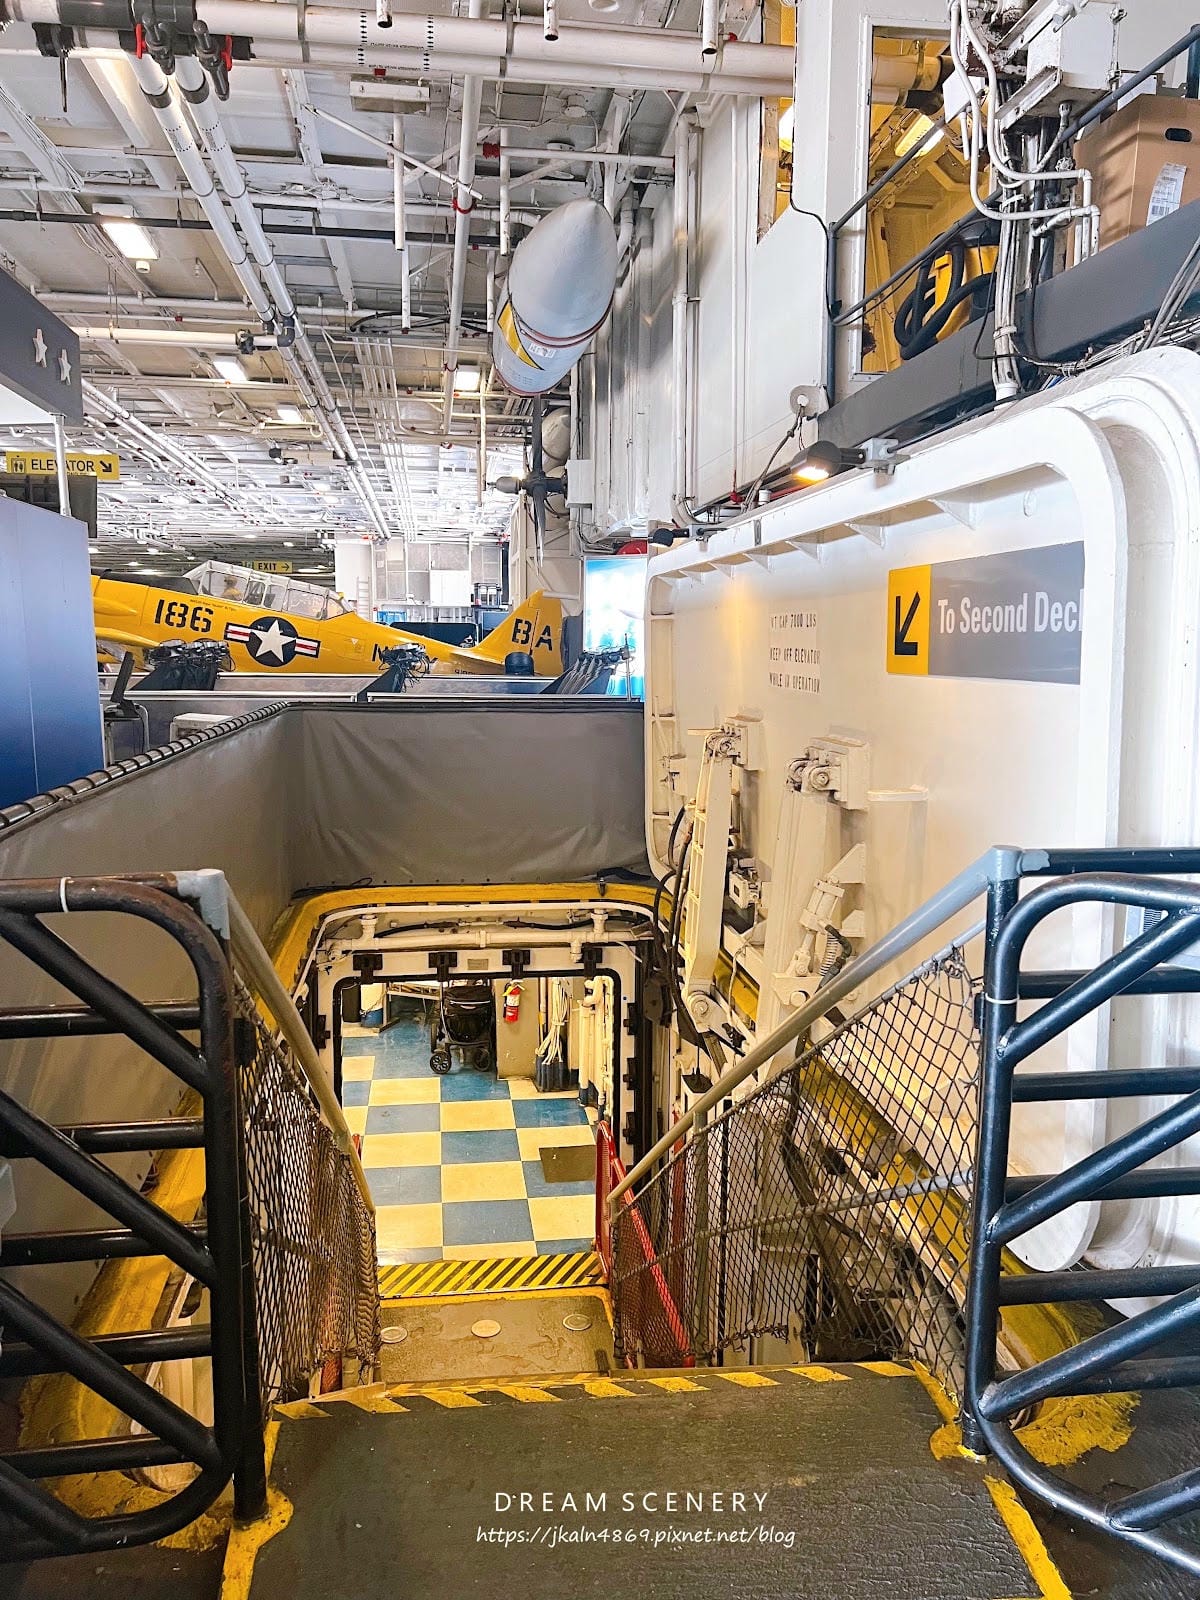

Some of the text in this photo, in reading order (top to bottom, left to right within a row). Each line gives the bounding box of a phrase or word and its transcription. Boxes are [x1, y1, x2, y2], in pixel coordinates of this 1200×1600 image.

[258, 562, 277, 571] EXIT
[154, 599, 214, 633] 186
[937, 599, 955, 634] To
[960, 592, 1028, 634] Second
